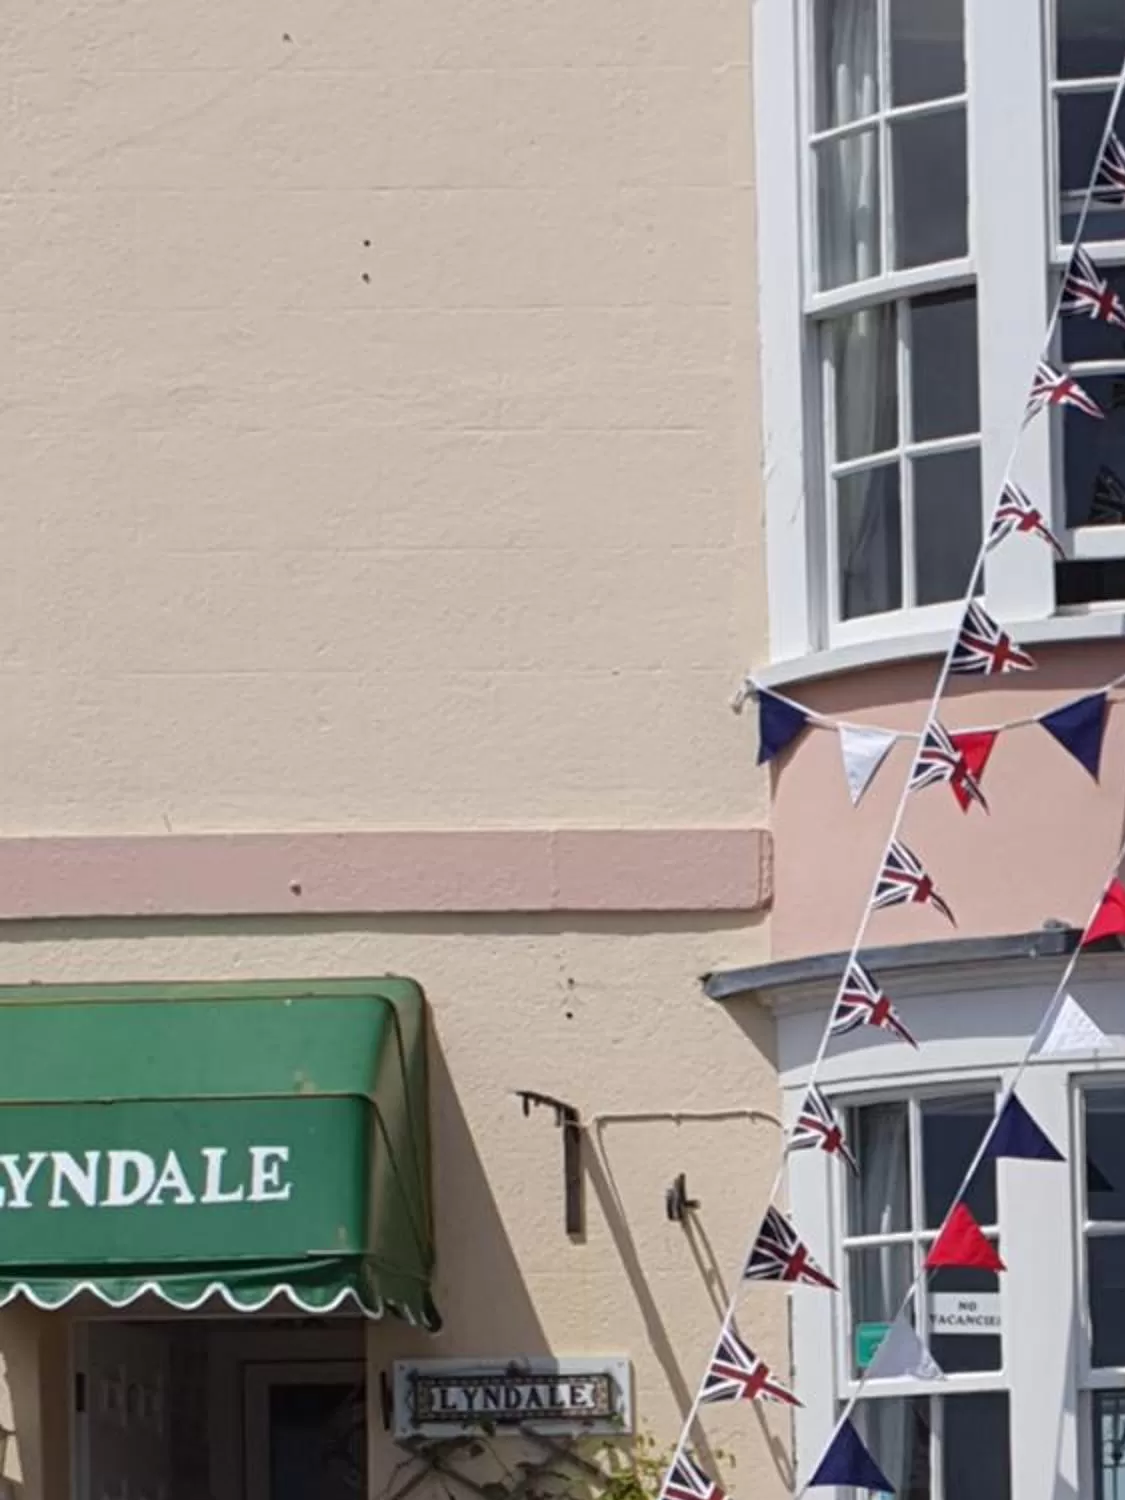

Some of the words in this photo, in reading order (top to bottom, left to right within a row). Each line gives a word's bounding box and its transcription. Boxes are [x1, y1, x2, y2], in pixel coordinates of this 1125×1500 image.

[0, 1146, 291, 1208] YNDALE
[958, 1301, 977, 1311] NO
[440, 1385, 587, 1410] LYNDALE
